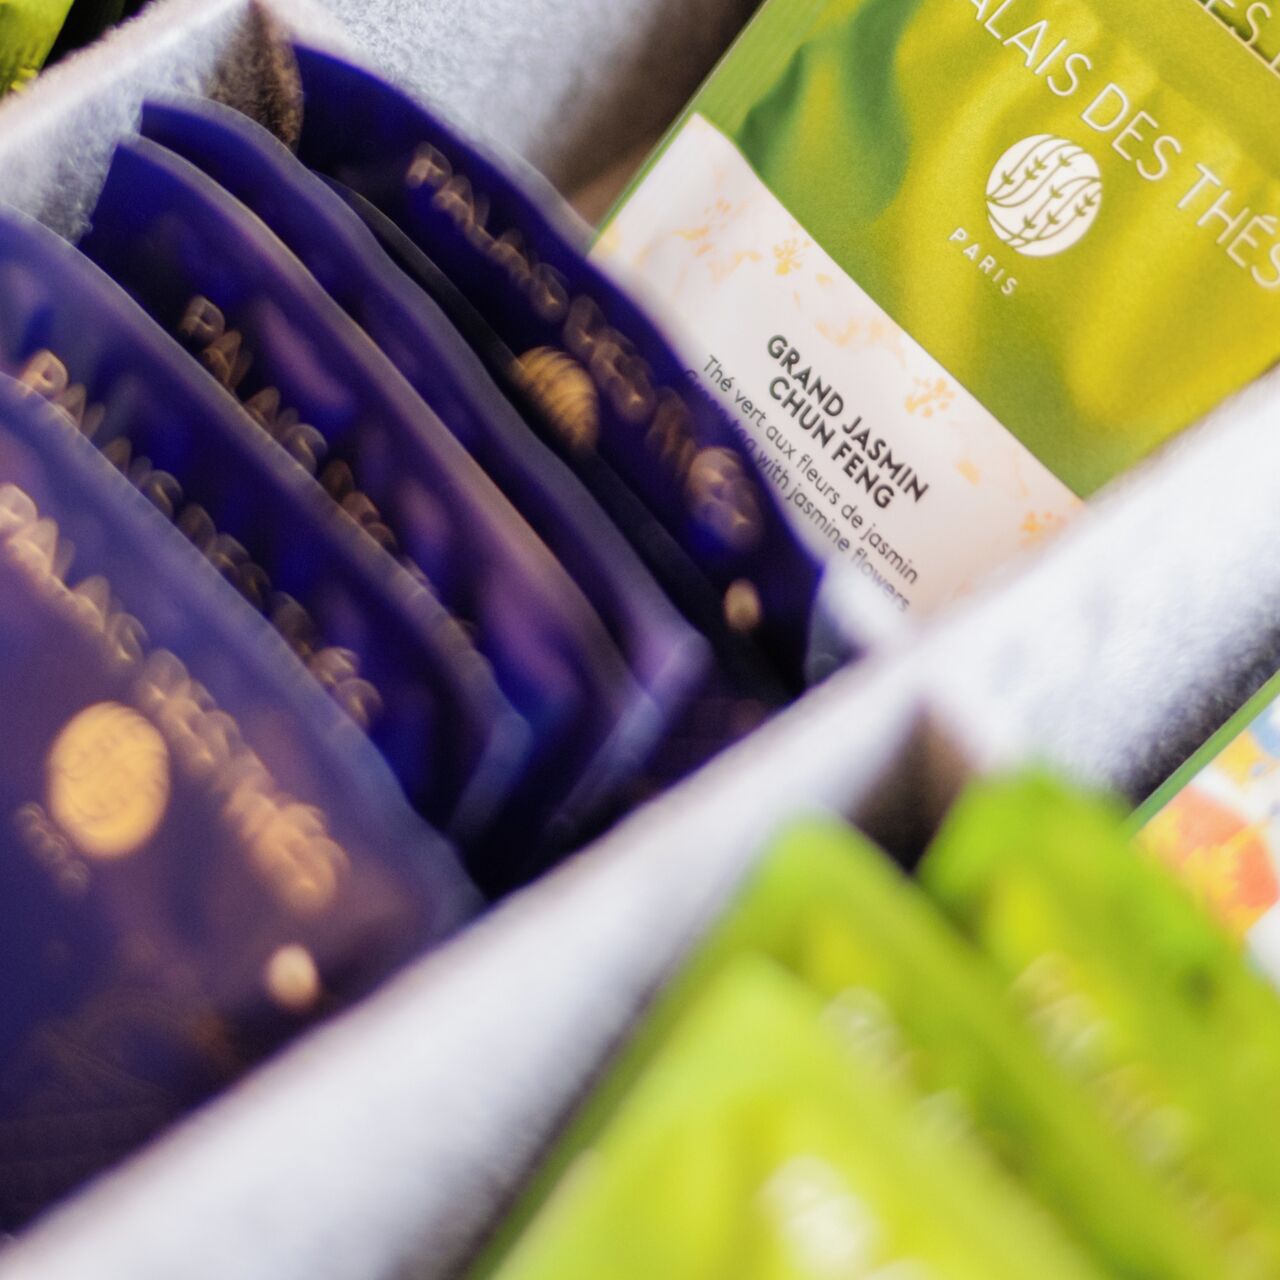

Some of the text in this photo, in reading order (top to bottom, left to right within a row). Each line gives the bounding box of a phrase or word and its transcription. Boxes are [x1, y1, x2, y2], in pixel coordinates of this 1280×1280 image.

[1081, 82, 1183, 182] DES
[948, 226, 1018, 296] PARIS
[703, 354, 735, 392] Thé
[735, 388, 767, 428] vert
[765, 425, 797, 461] aux
[795, 453, 840, 506] fleurs
[841, 500, 863, 530] de
[859, 524, 918, 586] jasmin
[767, 334, 930, 504] GRAND JASMIN
[769, 376, 895, 509] CHUN FENG
[786, 482, 851, 552] jasmine
